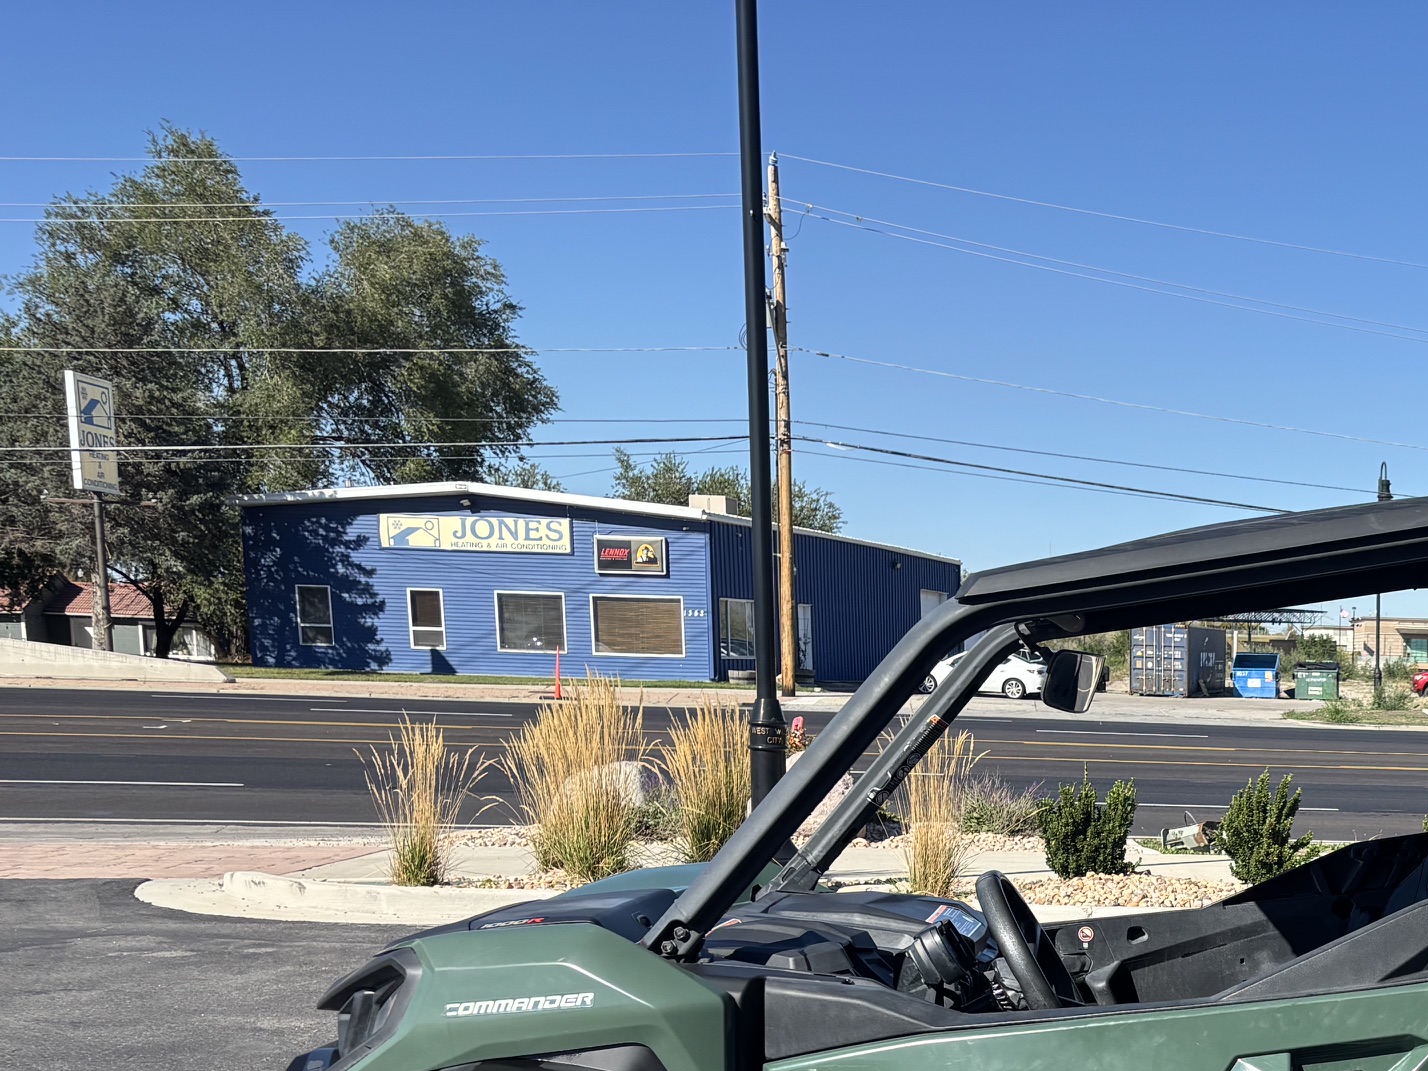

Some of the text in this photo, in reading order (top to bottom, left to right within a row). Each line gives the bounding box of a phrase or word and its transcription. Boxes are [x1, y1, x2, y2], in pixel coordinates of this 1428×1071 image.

[80, 430, 115, 448] JONES
[84, 479, 117, 490] CONDITIONING
[452, 517, 564, 542] JONES
[450, 541, 484, 549] HEATING
[511, 543, 567, 551] CONDITIONING
[601, 548, 630, 556] LENNOX
[446, 992, 595, 1017] COMMANDER
